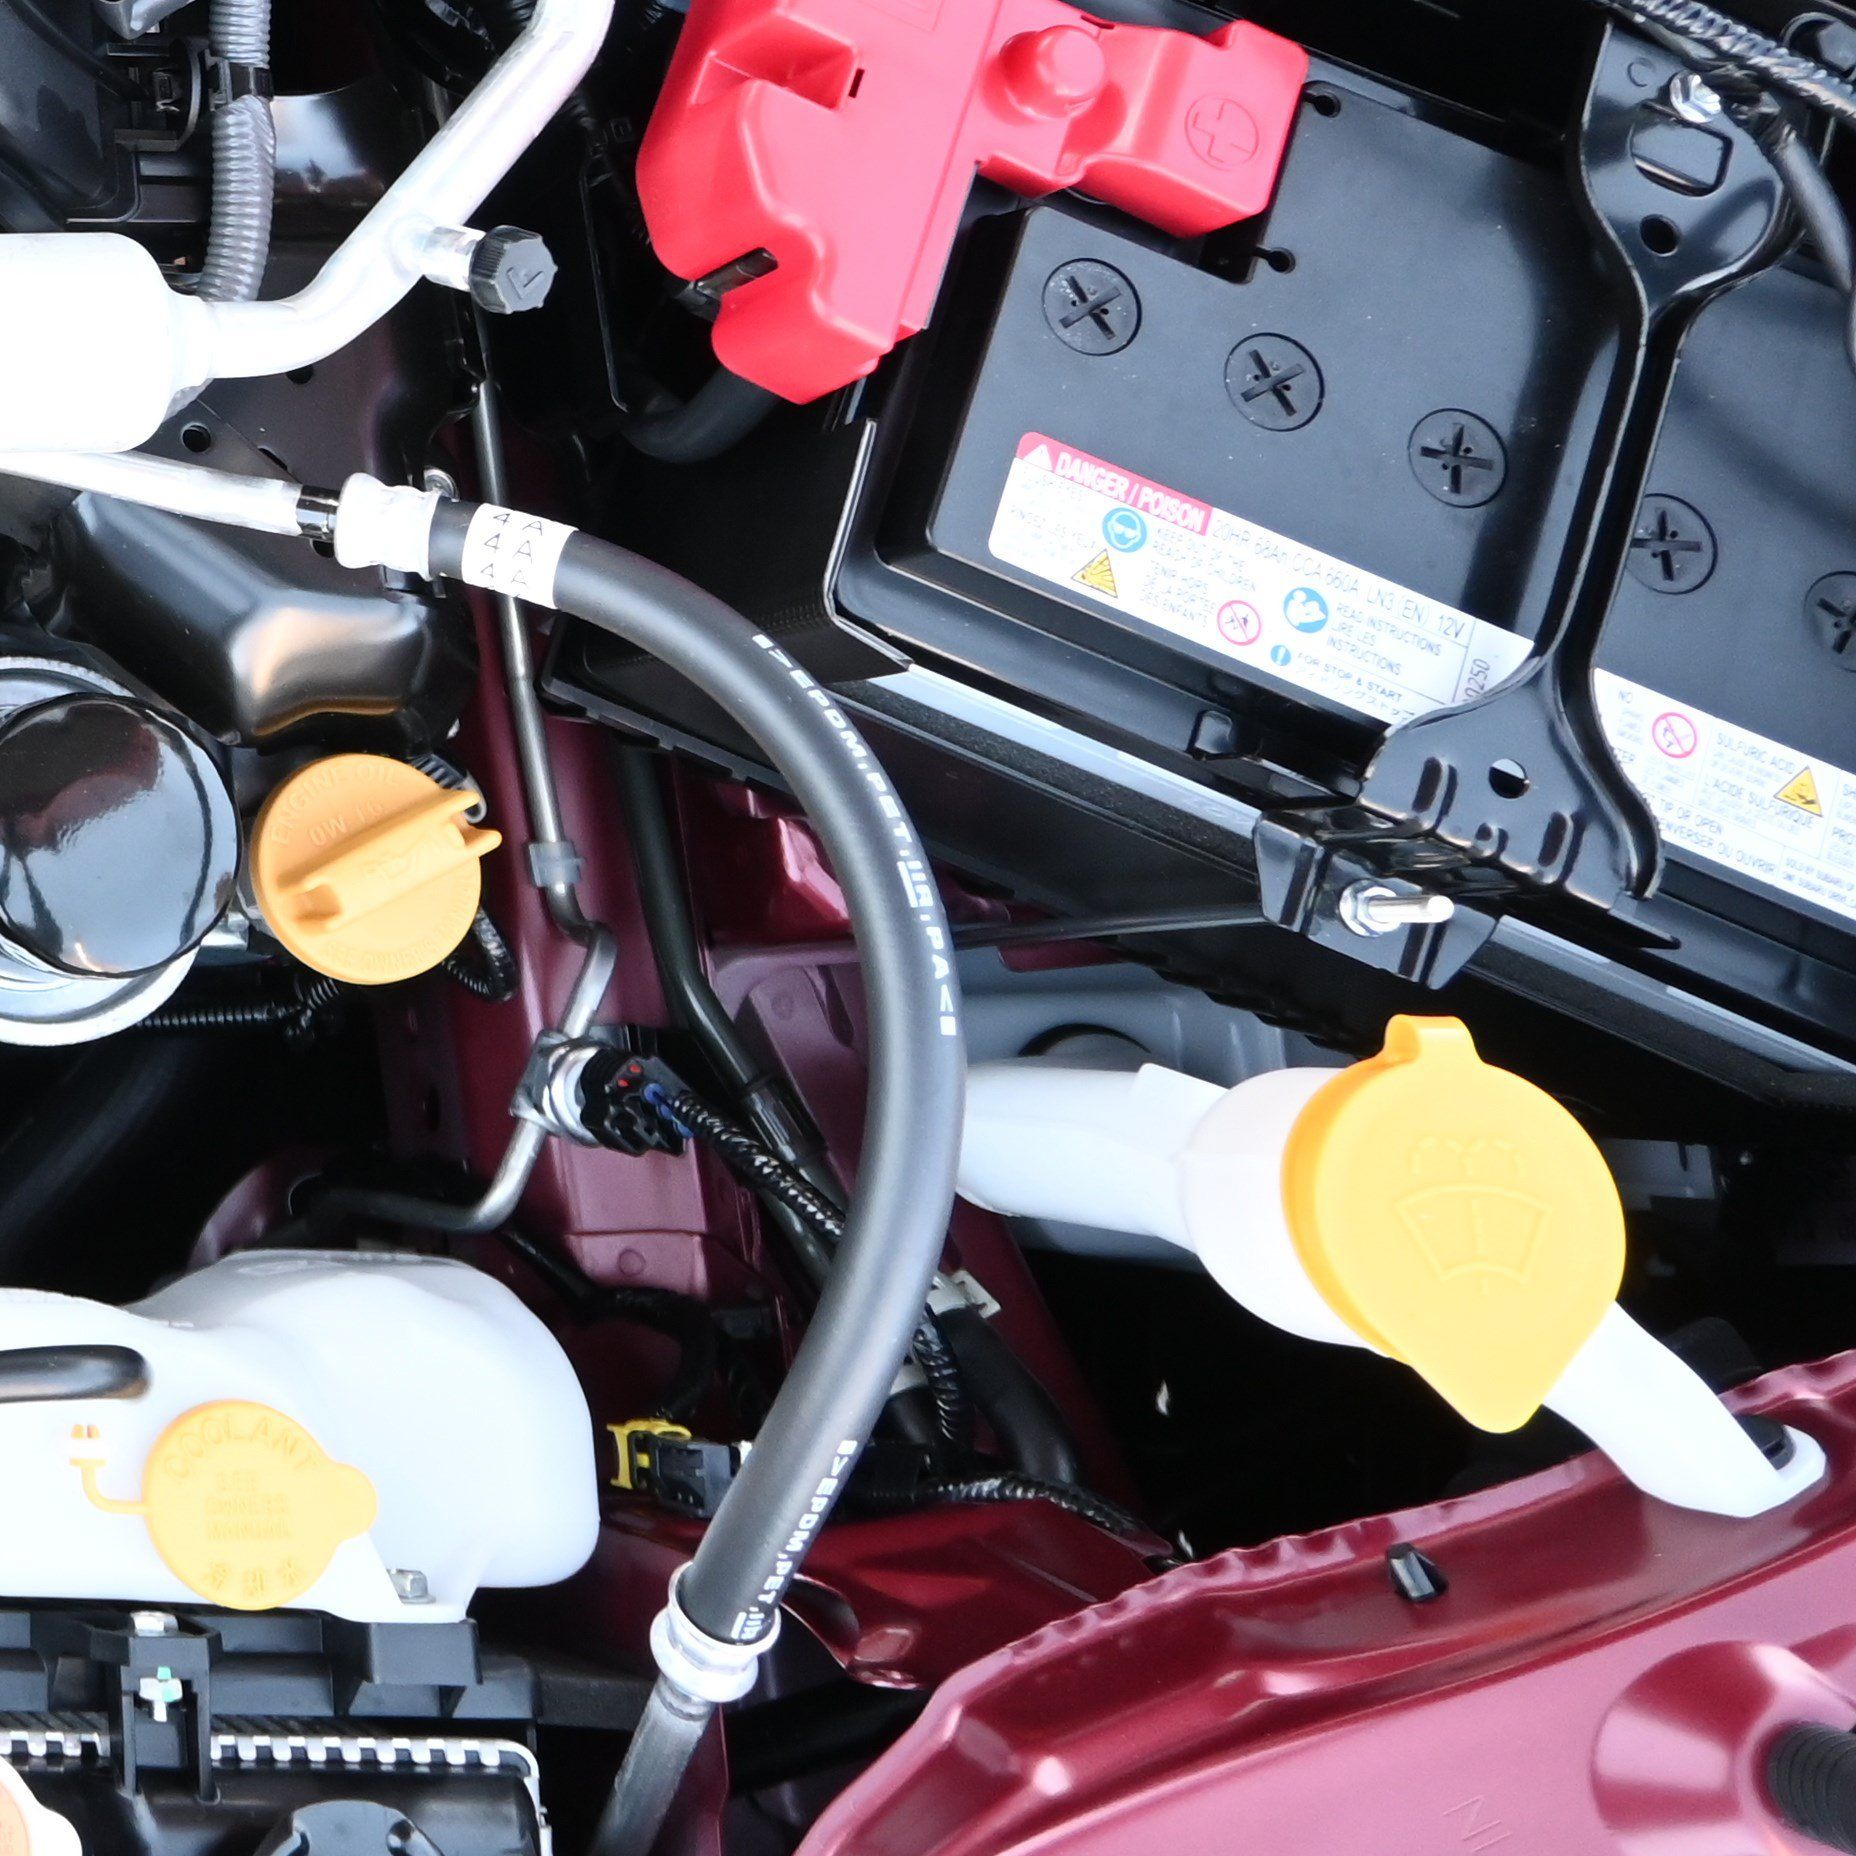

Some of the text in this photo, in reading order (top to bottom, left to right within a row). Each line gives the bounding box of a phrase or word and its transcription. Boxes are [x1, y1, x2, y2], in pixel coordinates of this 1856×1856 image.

[1054, 451, 1130, 501] DANGER
[1138, 486, 1205, 533] POISON
[512, 540, 533, 564] A
[1364, 614, 1443, 656] INSTRUCTIONS
[1434, 615, 1466, 640] 12V
[1325, 634, 1402, 675] INSTRUCTIONS
[1322, 661, 1352, 681] STOP
[1364, 679, 1403, 703] START
[1768, 755, 1796, 774] ACID
[270, 763, 400, 846] ENGINE OIL
[1692, 813, 1725, 834] OPEN
[1716, 842, 1735, 857] OU
[165, 1414, 319, 1479] COOLANT
